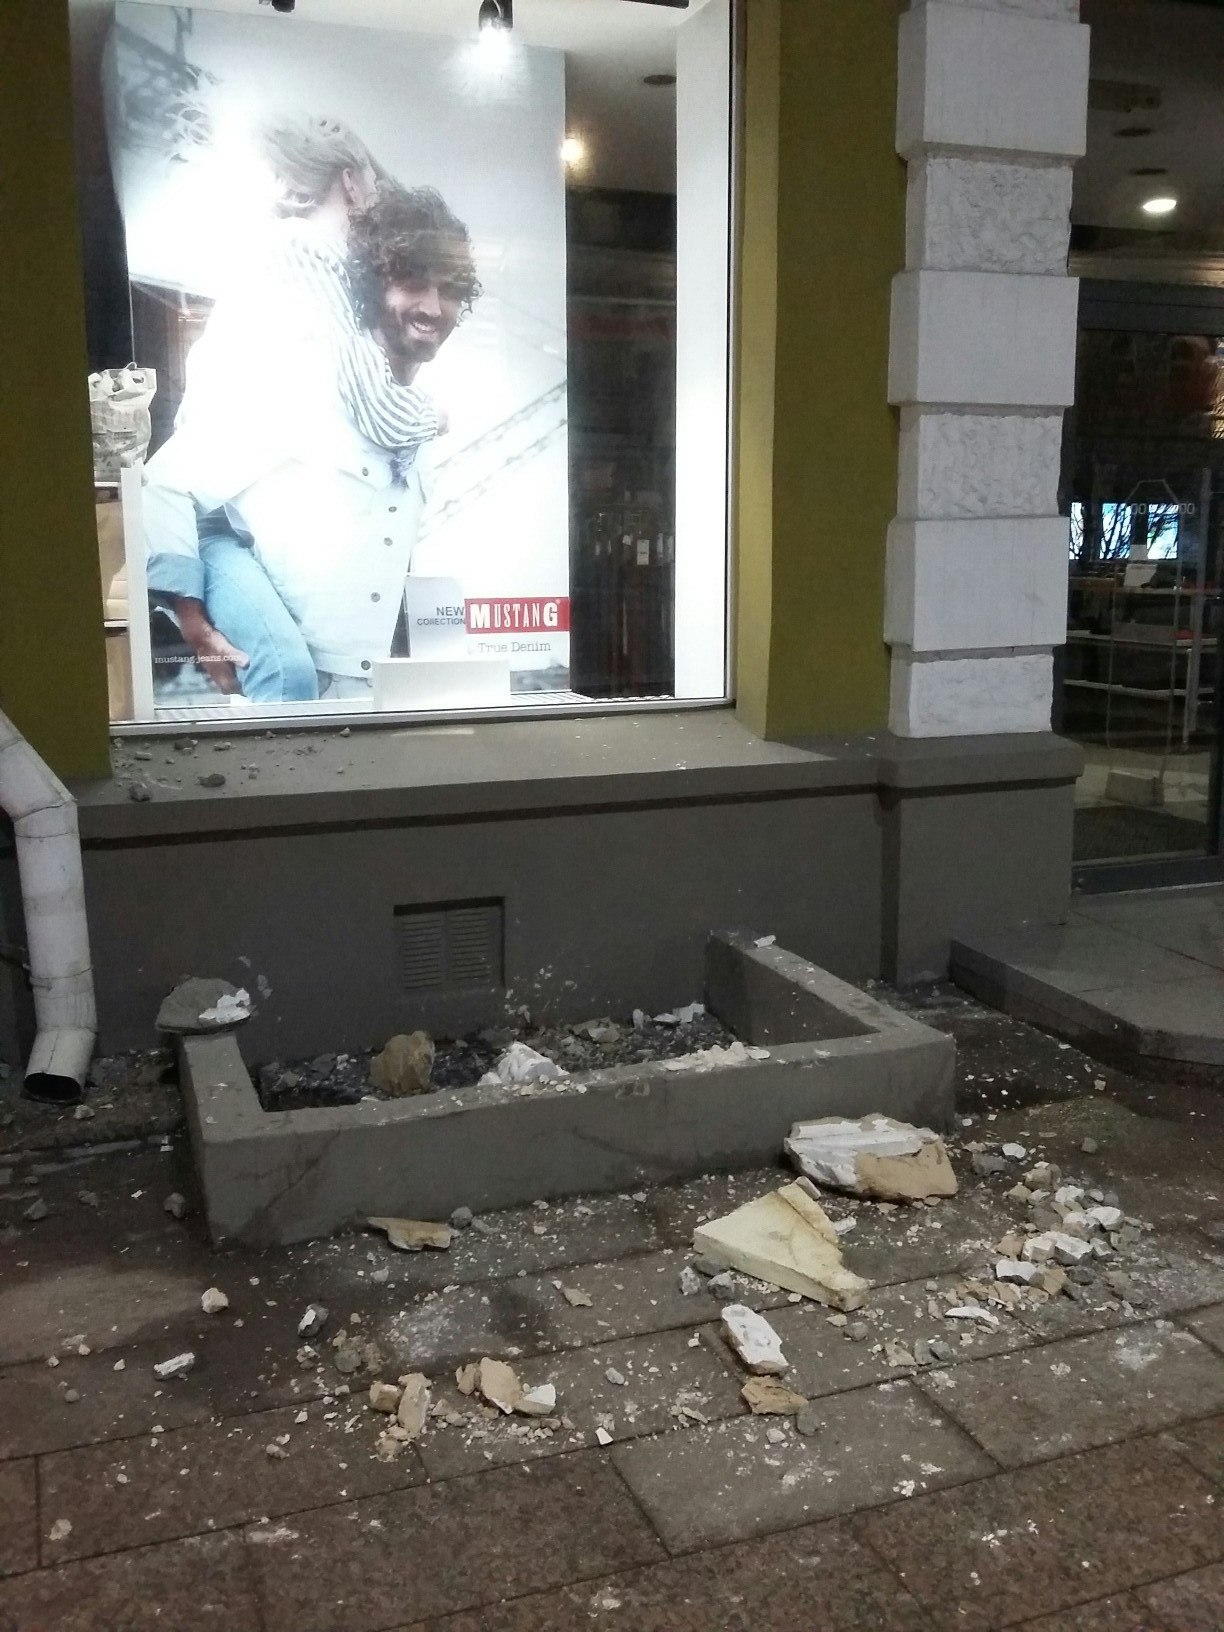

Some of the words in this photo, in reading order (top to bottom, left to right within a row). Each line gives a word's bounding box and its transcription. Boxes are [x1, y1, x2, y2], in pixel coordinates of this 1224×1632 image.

[436, 606, 465, 616] NEW
[470, 602, 558, 629] MUSTANG
[478, 642, 508, 653] True
[511, 641, 552, 653] Denim
